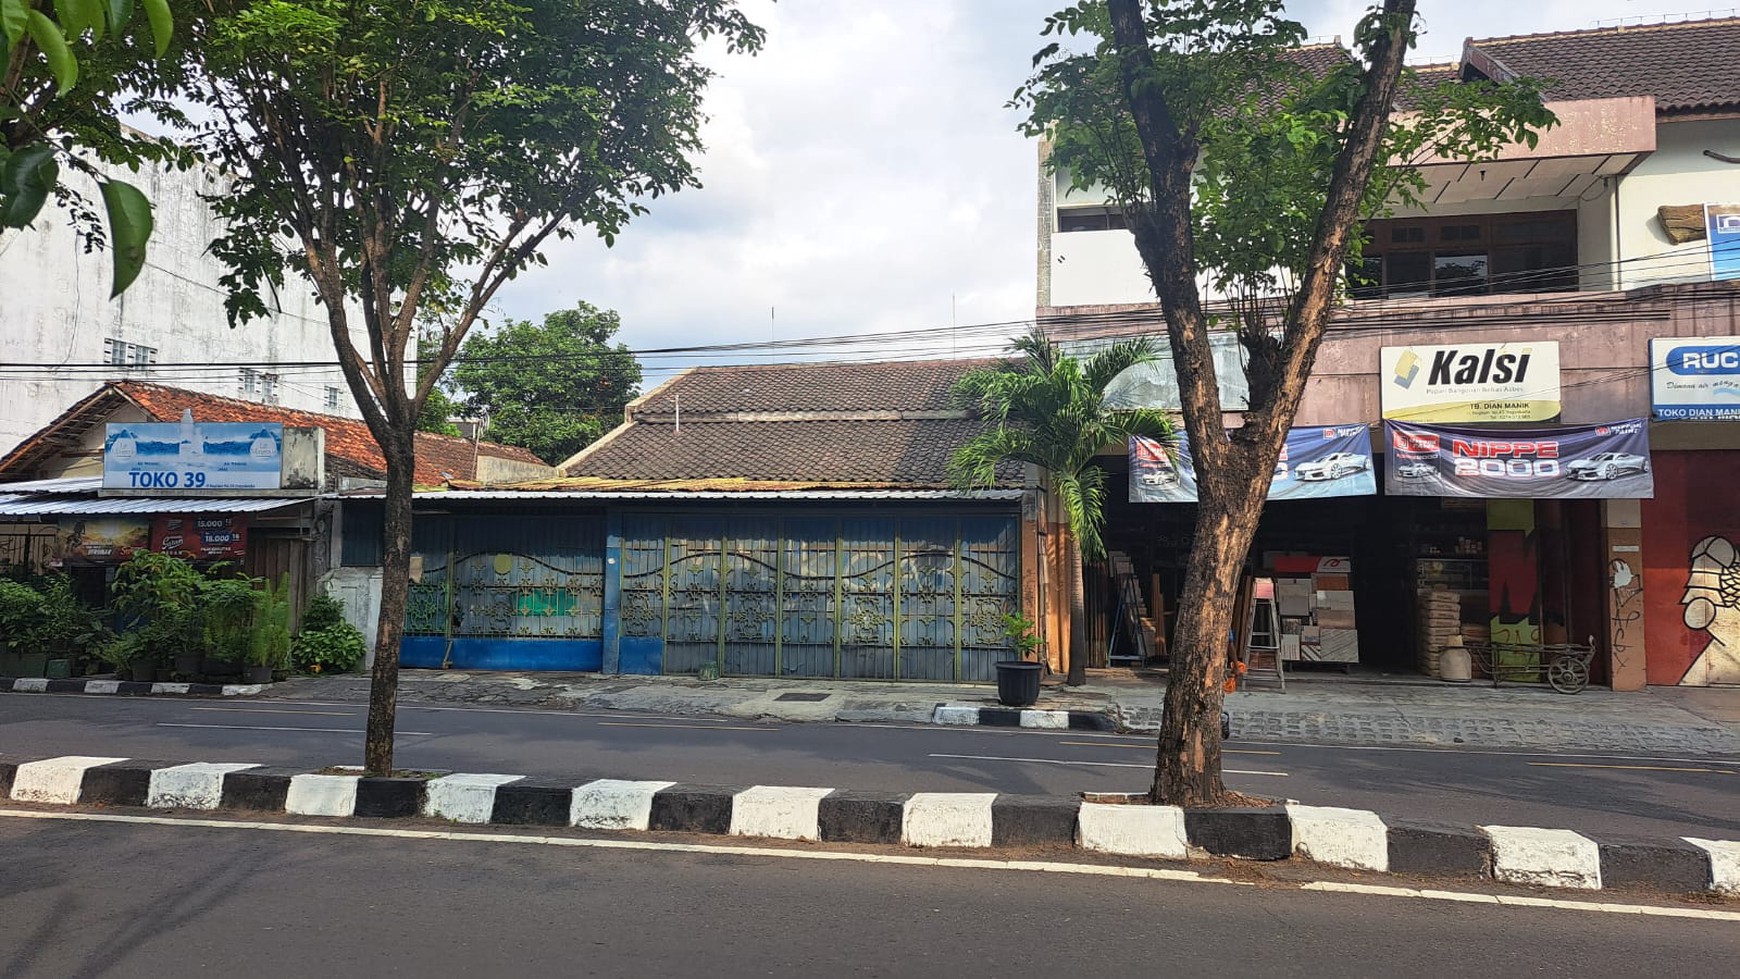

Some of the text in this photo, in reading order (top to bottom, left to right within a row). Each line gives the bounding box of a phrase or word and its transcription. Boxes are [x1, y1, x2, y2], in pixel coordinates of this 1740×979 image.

[1428, 348, 1533, 386] Kalsi
[1683, 352, 1739, 369] RUC
[1658, 408, 1687, 417] TOKO
[1689, 408, 1713, 417] DIAN
[1452, 439, 1559, 459] NIPPE
[1454, 458, 1561, 477] 2000
[129, 471, 206, 488] TOKO 39
